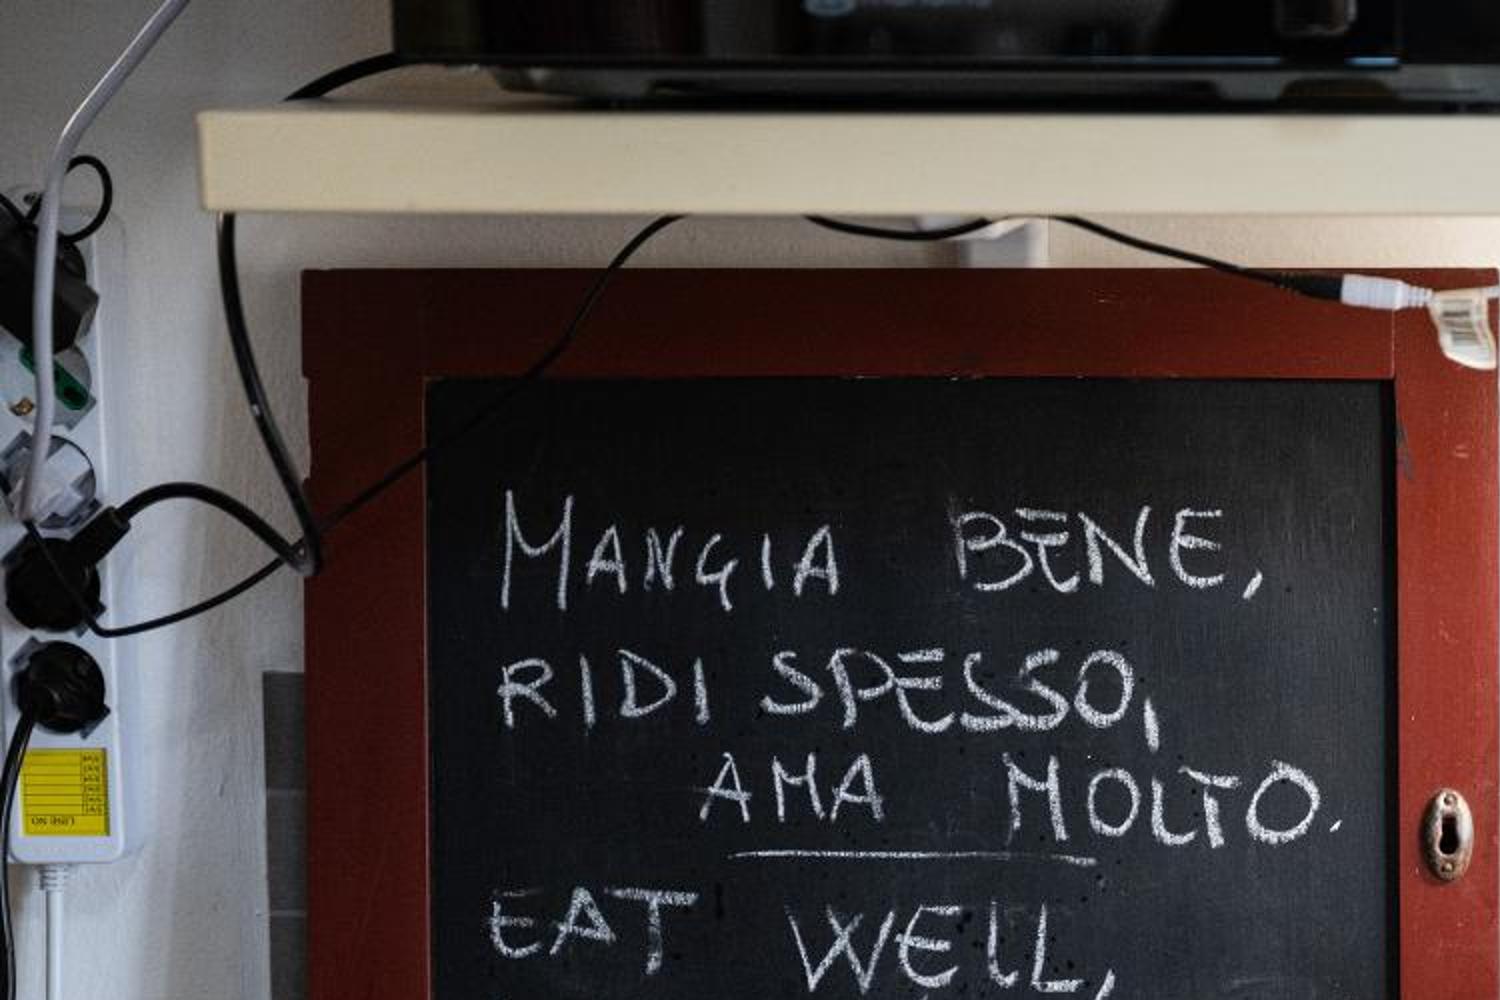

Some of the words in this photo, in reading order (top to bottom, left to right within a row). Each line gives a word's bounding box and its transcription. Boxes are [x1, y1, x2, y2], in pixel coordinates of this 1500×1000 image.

[501, 490, 840, 612] MANGIA
[955, 505, 1264, 601] BENE,
[497, 649, 710, 728] RIDI
[760, 647, 1161, 753] SPESSO,
[699, 751, 884, 823] AMA
[1003, 752, 1344, 850] MOLTO.
[490, 887, 698, 975] EAT
